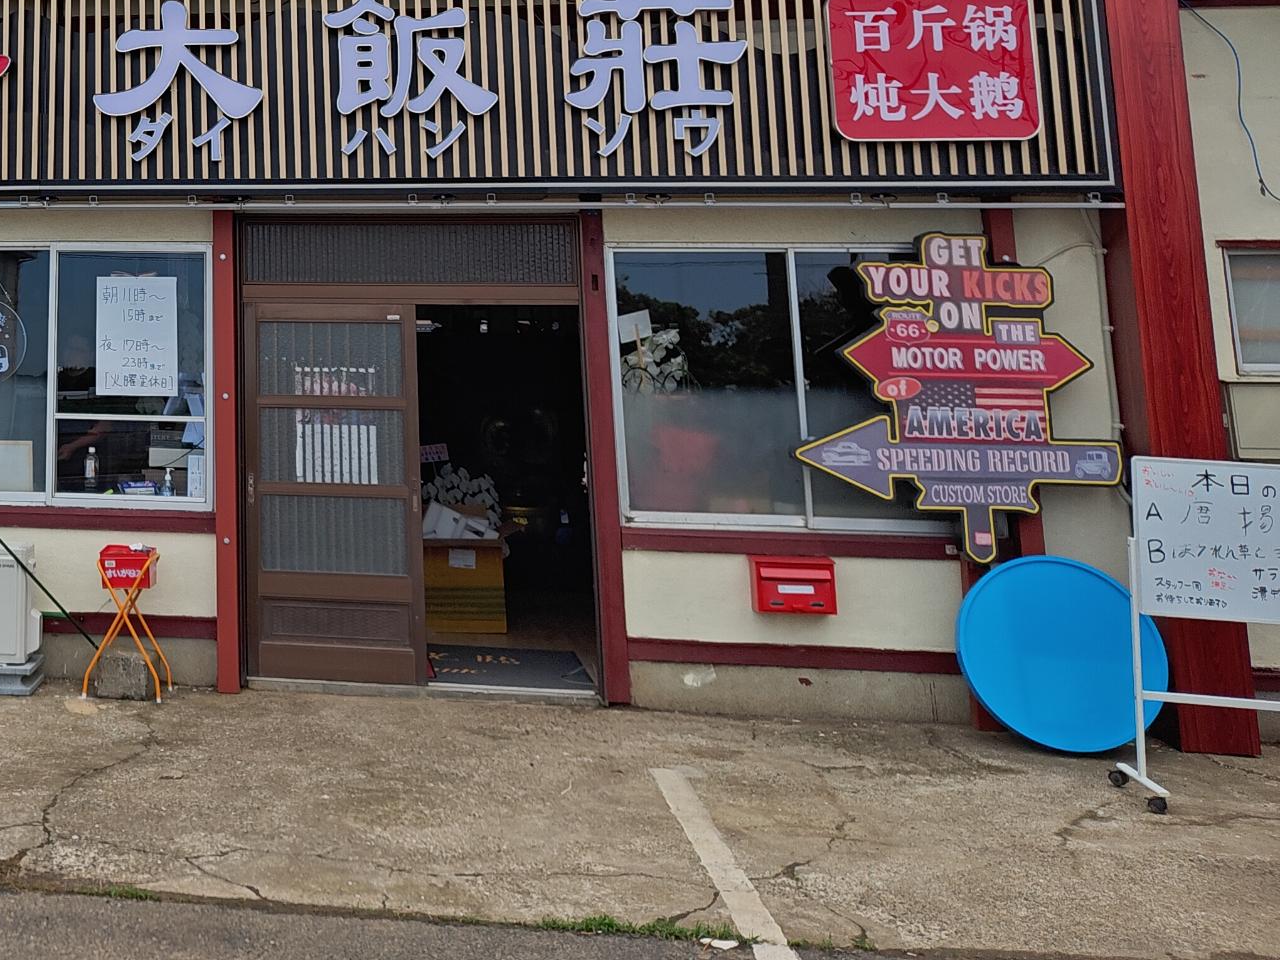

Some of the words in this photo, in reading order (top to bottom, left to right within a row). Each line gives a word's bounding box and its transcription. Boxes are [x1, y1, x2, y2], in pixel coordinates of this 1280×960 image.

[845, 4, 1018, 53] 百斤锅
[848, 71, 1024, 122] 炖大鹅
[929, 238, 982, 267] GET
[101, 285, 119, 305] 朝
[868, 265, 952, 298] YOUR
[962, 271, 1049, 302] KICKS
[891, 311, 922, 321] ROUTE
[939, 302, 982, 330] ON
[99, 334, 117, 352] 夜
[895, 323, 921, 338] 66
[997, 323, 1036, 343] THE
[891, 346, 964, 371] MOTOR
[974, 348, 1045, 373] POWER
[886, 379, 908, 397] of
[904, 404, 1045, 443] AMERICA
[876, 446, 981, 473] SPEEDING
[988, 449, 1072, 474] RECORD
[931, 484, 986, 504] CUSTOM
[986, 485, 1028, 505] STORE
[1191, 469, 1277, 499] 本日の
[1145, 502, 1163, 521] A
[1147, 538, 1166, 564] B
